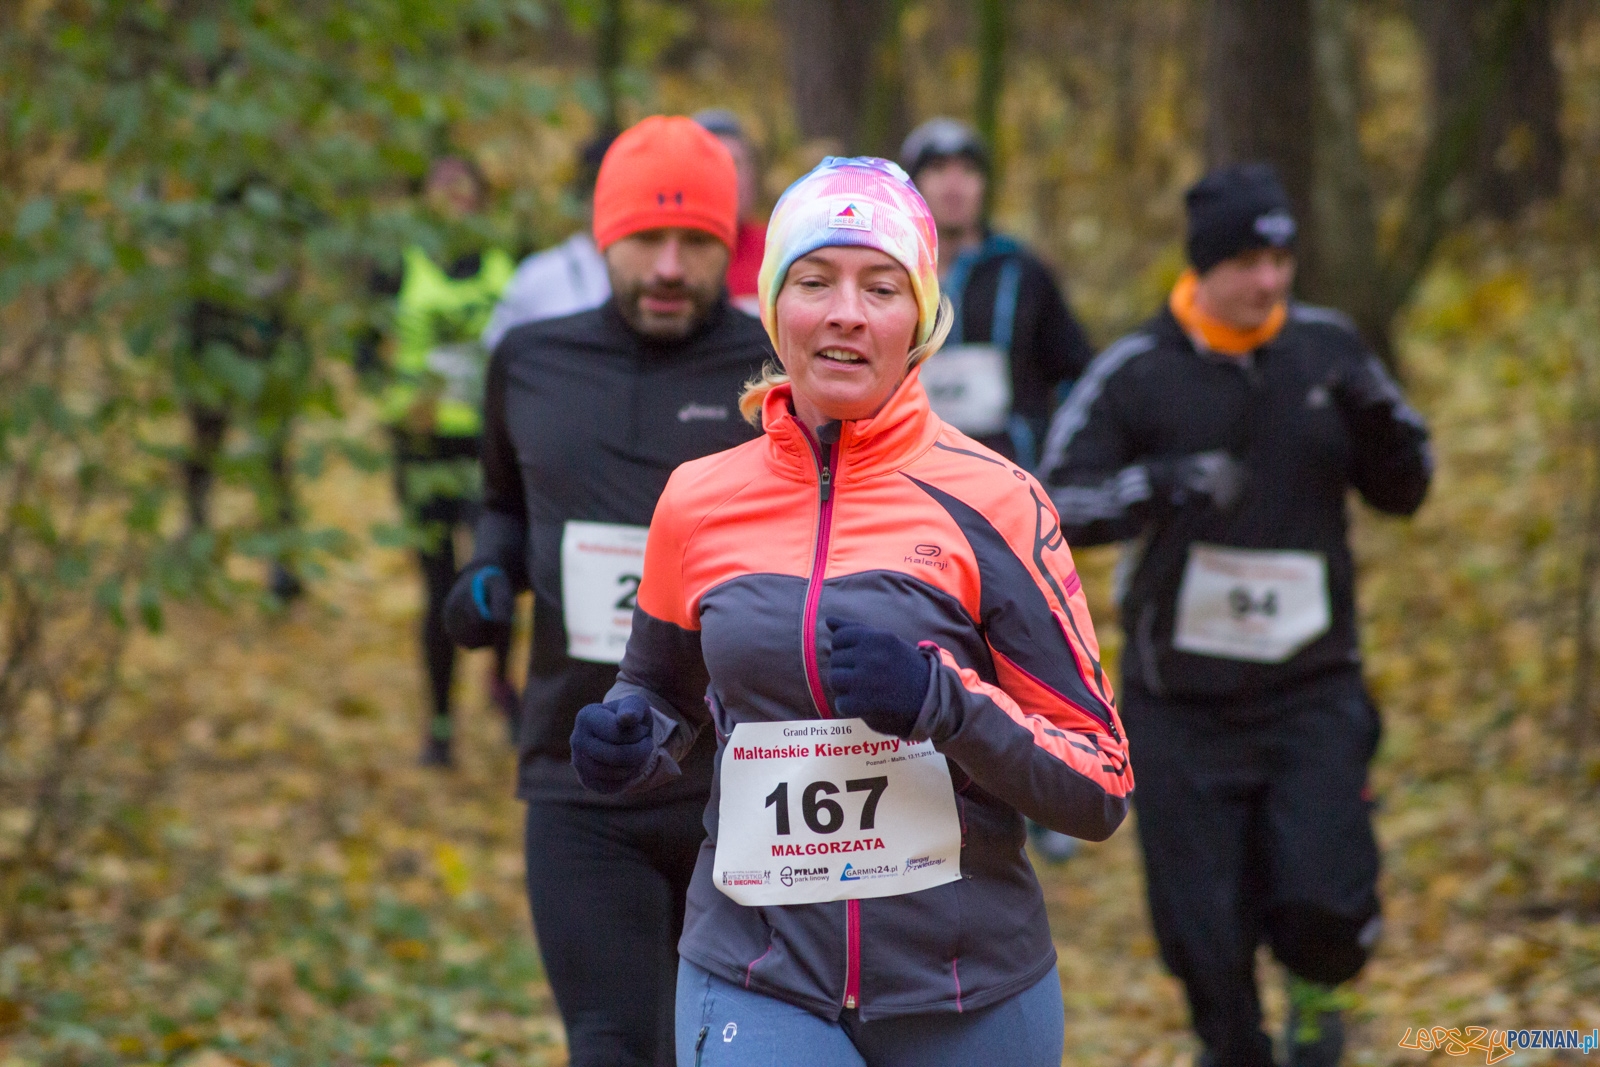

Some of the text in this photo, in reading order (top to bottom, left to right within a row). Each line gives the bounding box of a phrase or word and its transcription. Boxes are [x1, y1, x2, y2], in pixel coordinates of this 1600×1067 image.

[904, 556, 948, 570] Kalenji
[783, 725, 852, 737] Grand Prix 2016
[733, 739, 900, 760] Maltańskie Kieretyny
[764, 775, 889, 836] 167
[771, 837, 886, 857] MAŁGORZATA
[794, 867, 829, 876] PYRLAND
[846, 865, 898, 876] GARMIN24.pl
